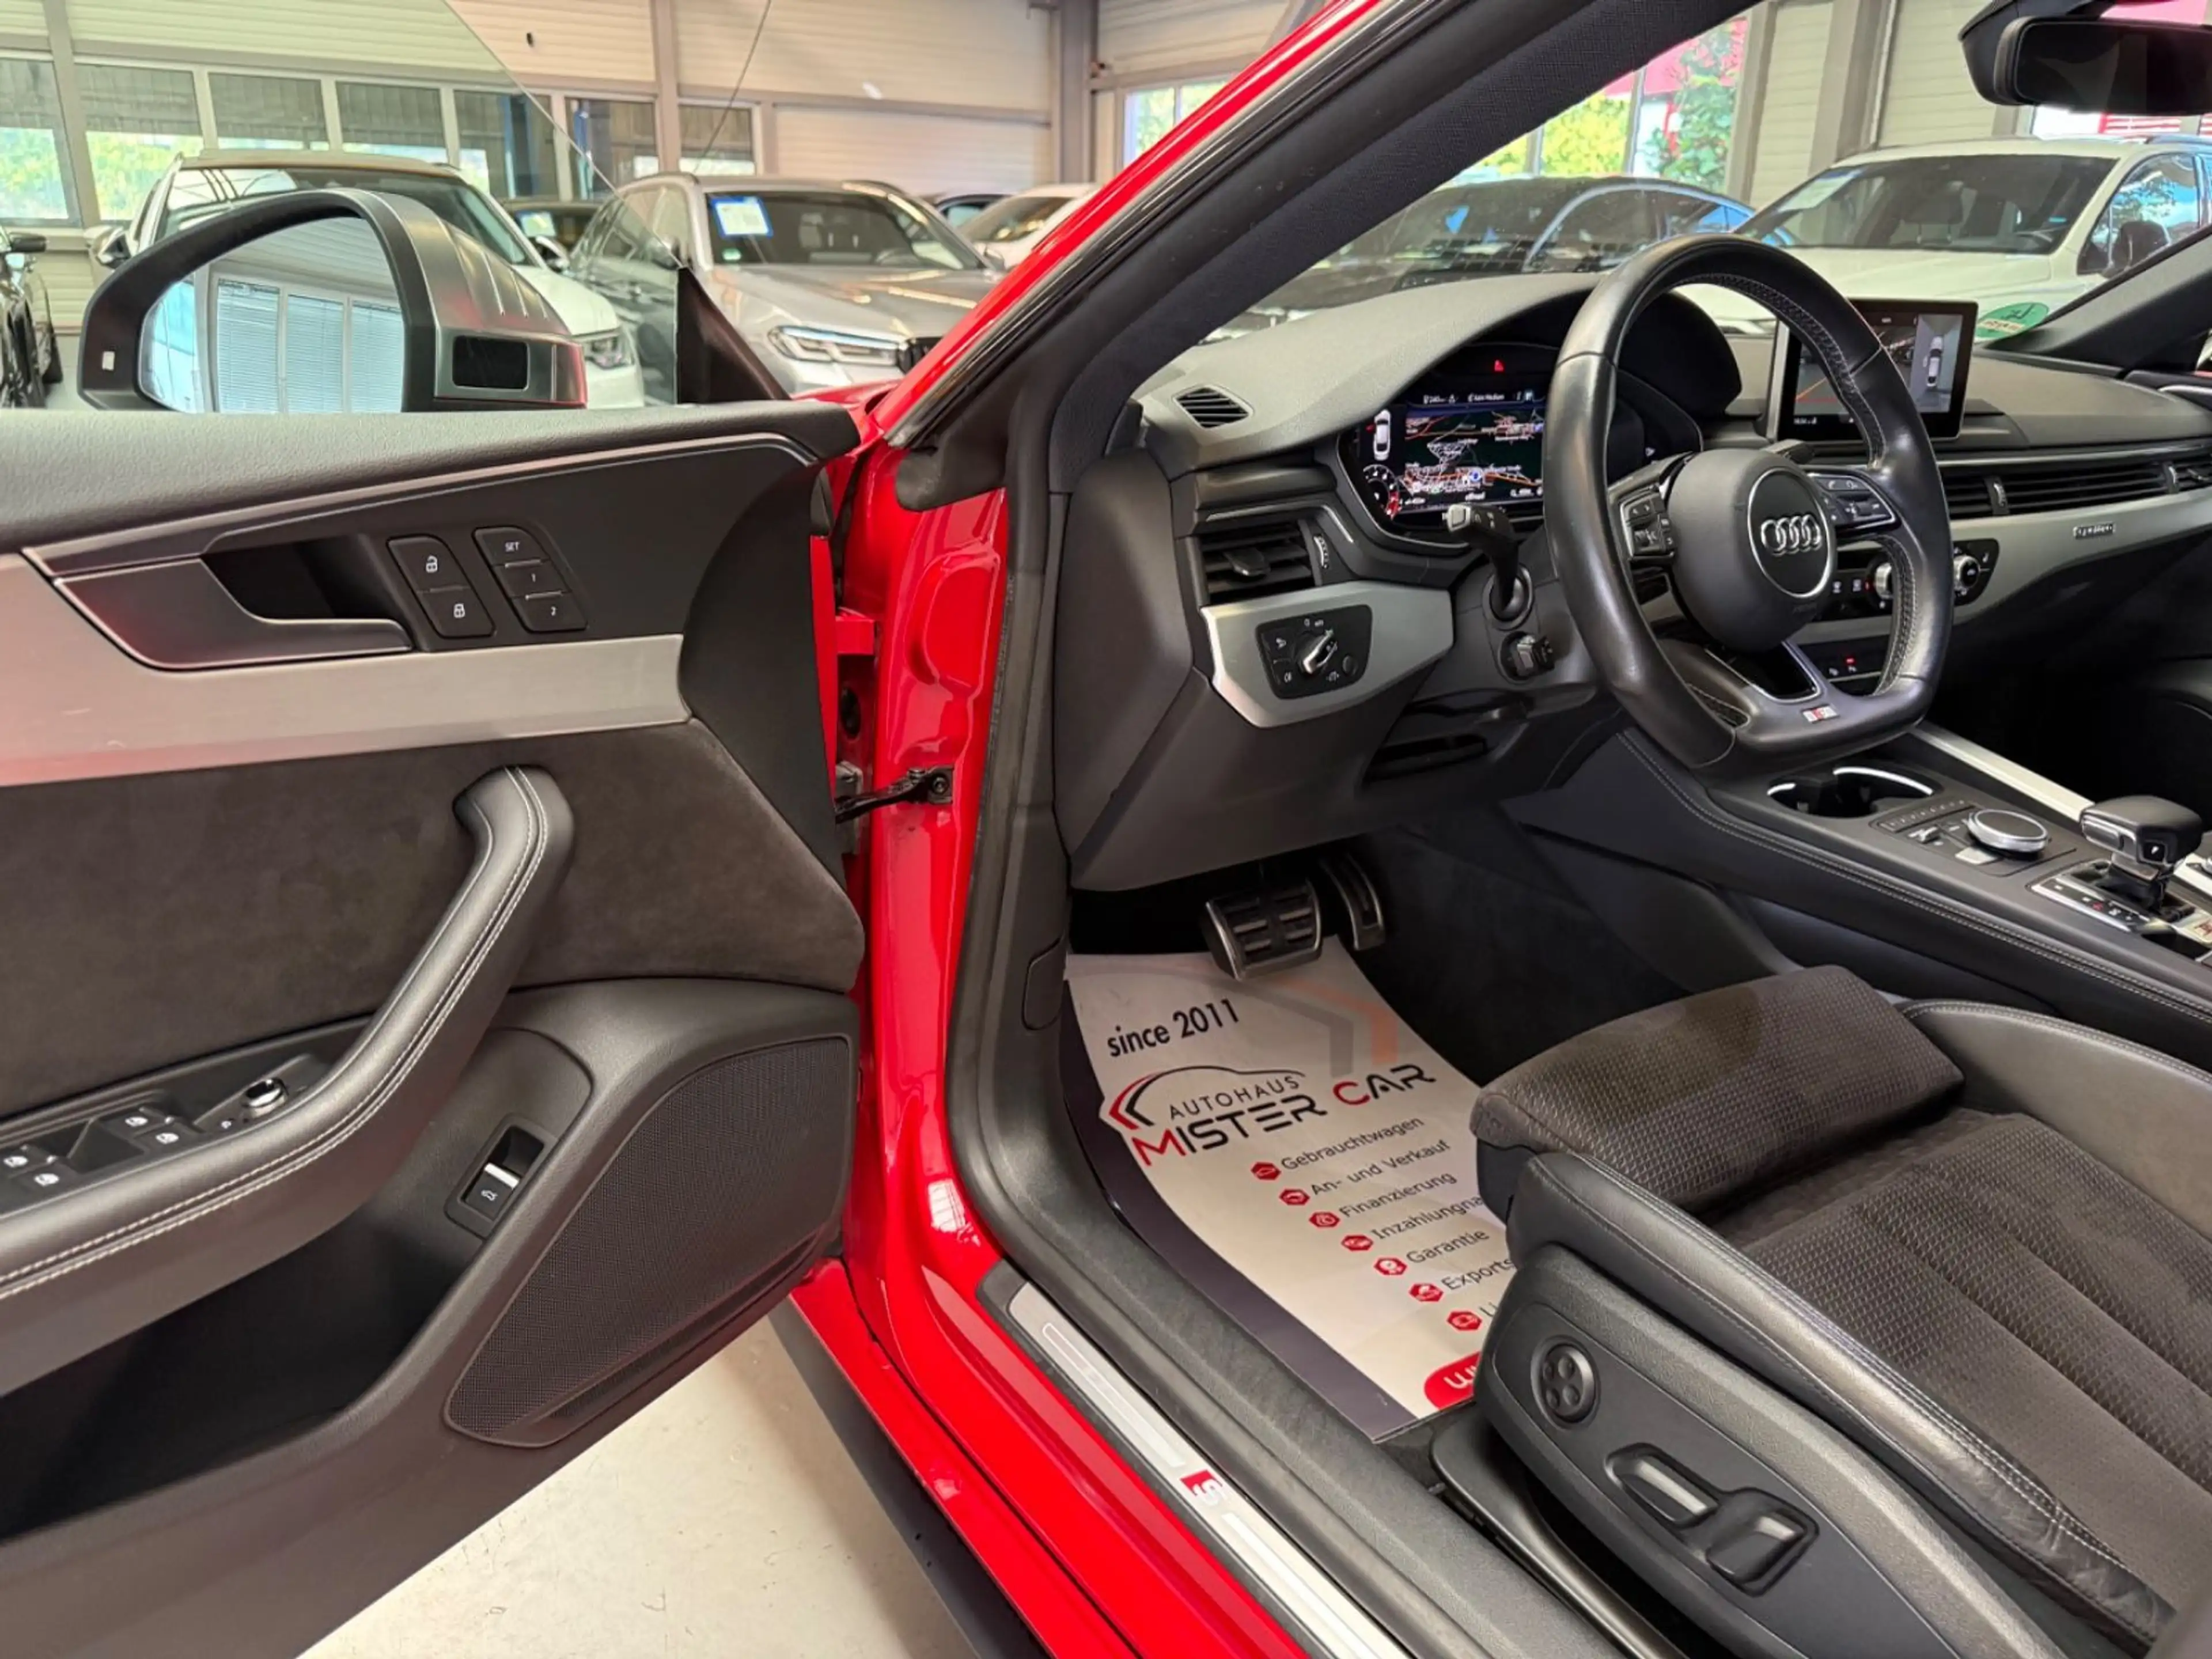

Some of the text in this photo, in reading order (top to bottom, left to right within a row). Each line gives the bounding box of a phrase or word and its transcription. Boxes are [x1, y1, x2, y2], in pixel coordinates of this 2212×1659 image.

[505, 541, 520, 552] SET
[1107, 998, 1239, 1058] since 2011
[1131, 1064, 1437, 1166] MISTER CAR
[1169, 1075, 1300, 1120] AUTOHAUS
[1281, 1116, 1425, 1171] Gebrauchtwagen
[1310, 1138, 1451, 1195] An- und Verkauf
[1338, 1172, 1458, 1218] Finanzierung
[1406, 1229, 1490, 1263] Garantie
